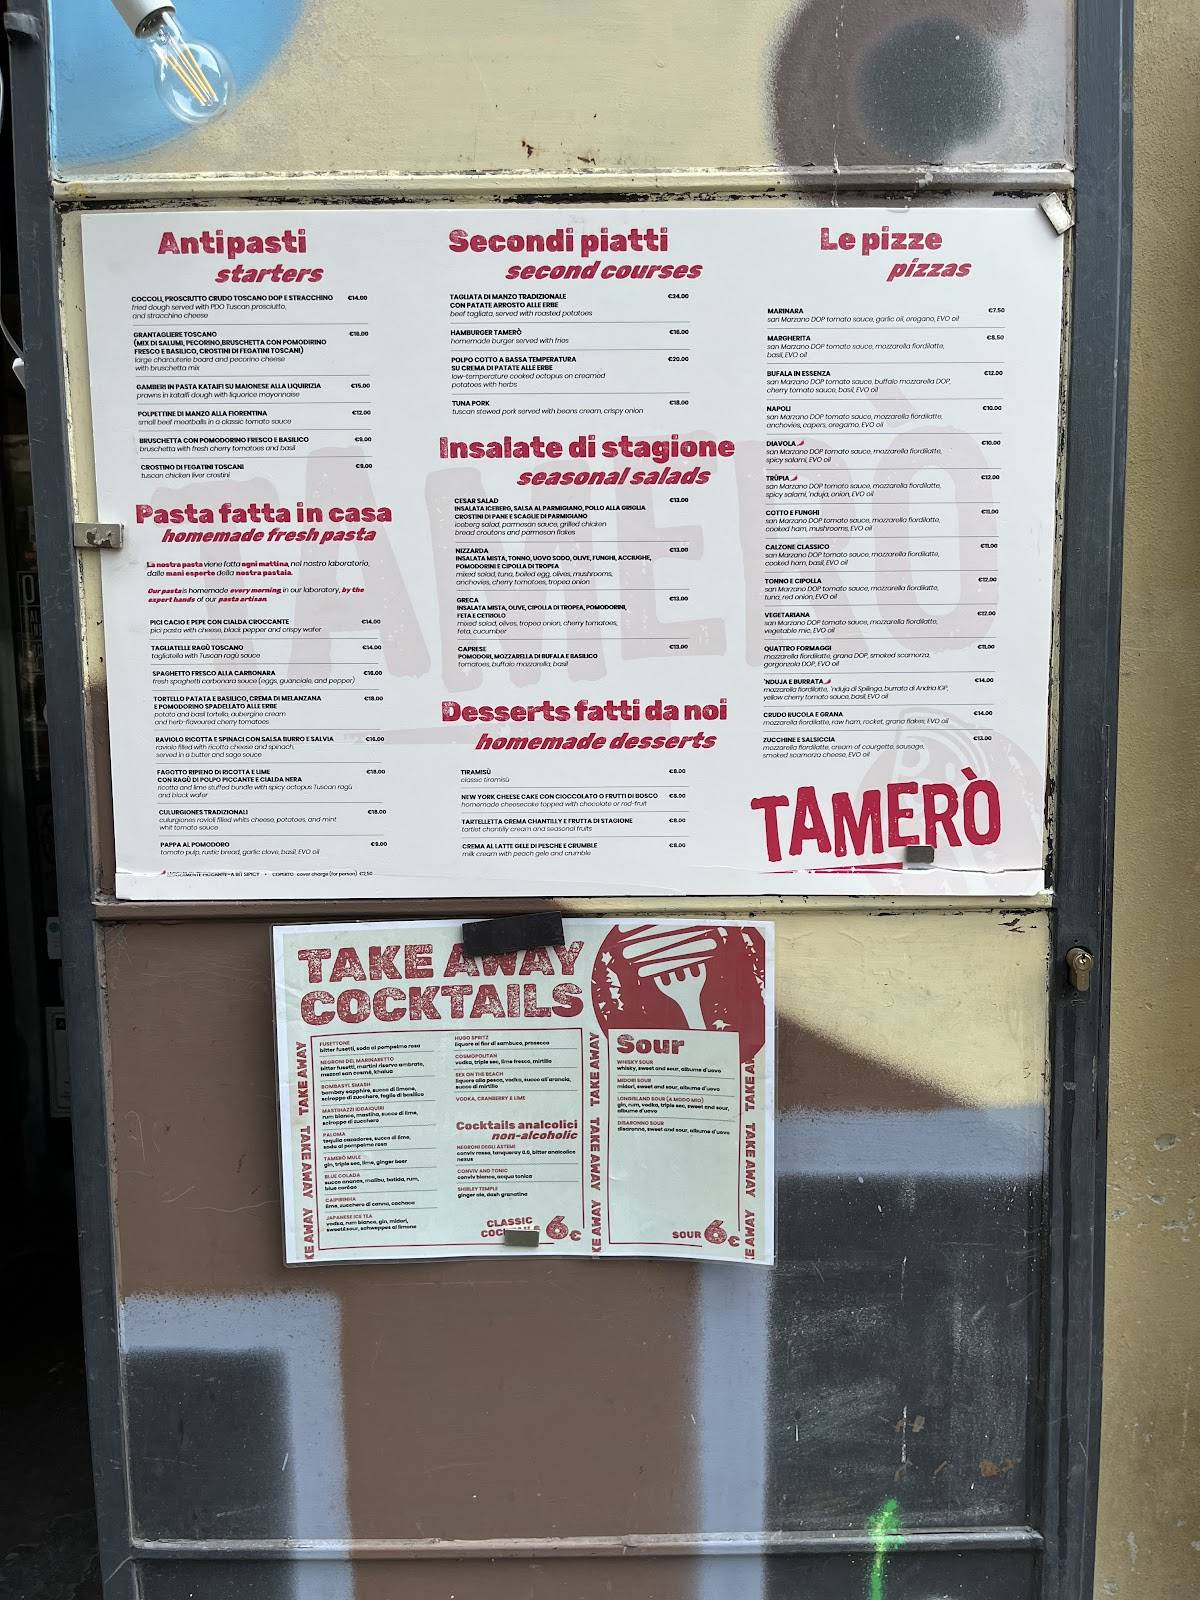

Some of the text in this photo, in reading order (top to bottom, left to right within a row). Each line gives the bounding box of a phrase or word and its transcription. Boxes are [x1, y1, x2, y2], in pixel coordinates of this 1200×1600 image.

[157, 229, 306, 259] Antipasti
[448, 227, 668, 257] Secondi piatti
[820, 226, 942, 255] Le pizze
[214, 264, 323, 283] starters
[505, 261, 703, 279] second courses
[887, 258, 971, 281] pizzas
[439, 434, 735, 463] Insalate di stagione
[516, 466, 711, 485] seasonal salads
[135, 501, 392, 524] Pasta fatta in casa
[161, 527, 377, 544] homemade fresh pasta
[441, 698, 727, 722] Desserts fatti da noi
[474, 732, 717, 750] homemade desserts
[460, 767, 491, 775] TIRAMISÙ
[751, 767, 1001, 862] TAMERÒ
[298, 941, 585, 983] TAKE AWAY
[301, 983, 585, 1026] COCKTAILS
[616, 1034, 685, 1055] Sour
[296, 1041, 309, 1115] TAKE AWAY
[590, 1032, 600, 1107] TAKE AWAY
[455, 1119, 578, 1130] Cocktails analcolici
[491, 1130, 578, 1140] non-alcoholic
[300, 1126, 313, 1198] TAKE AWAY
[590, 1118, 601, 1191] TAKE AWAY
[745, 1123, 756, 1198] TAKE AWAY
[303, 1208, 314, 1244] AWAY
[486, 1216, 533, 1227] CLASSIC
[591, 1200, 602, 1237] AWAY
[745, 1210, 755, 1247] AWAY
